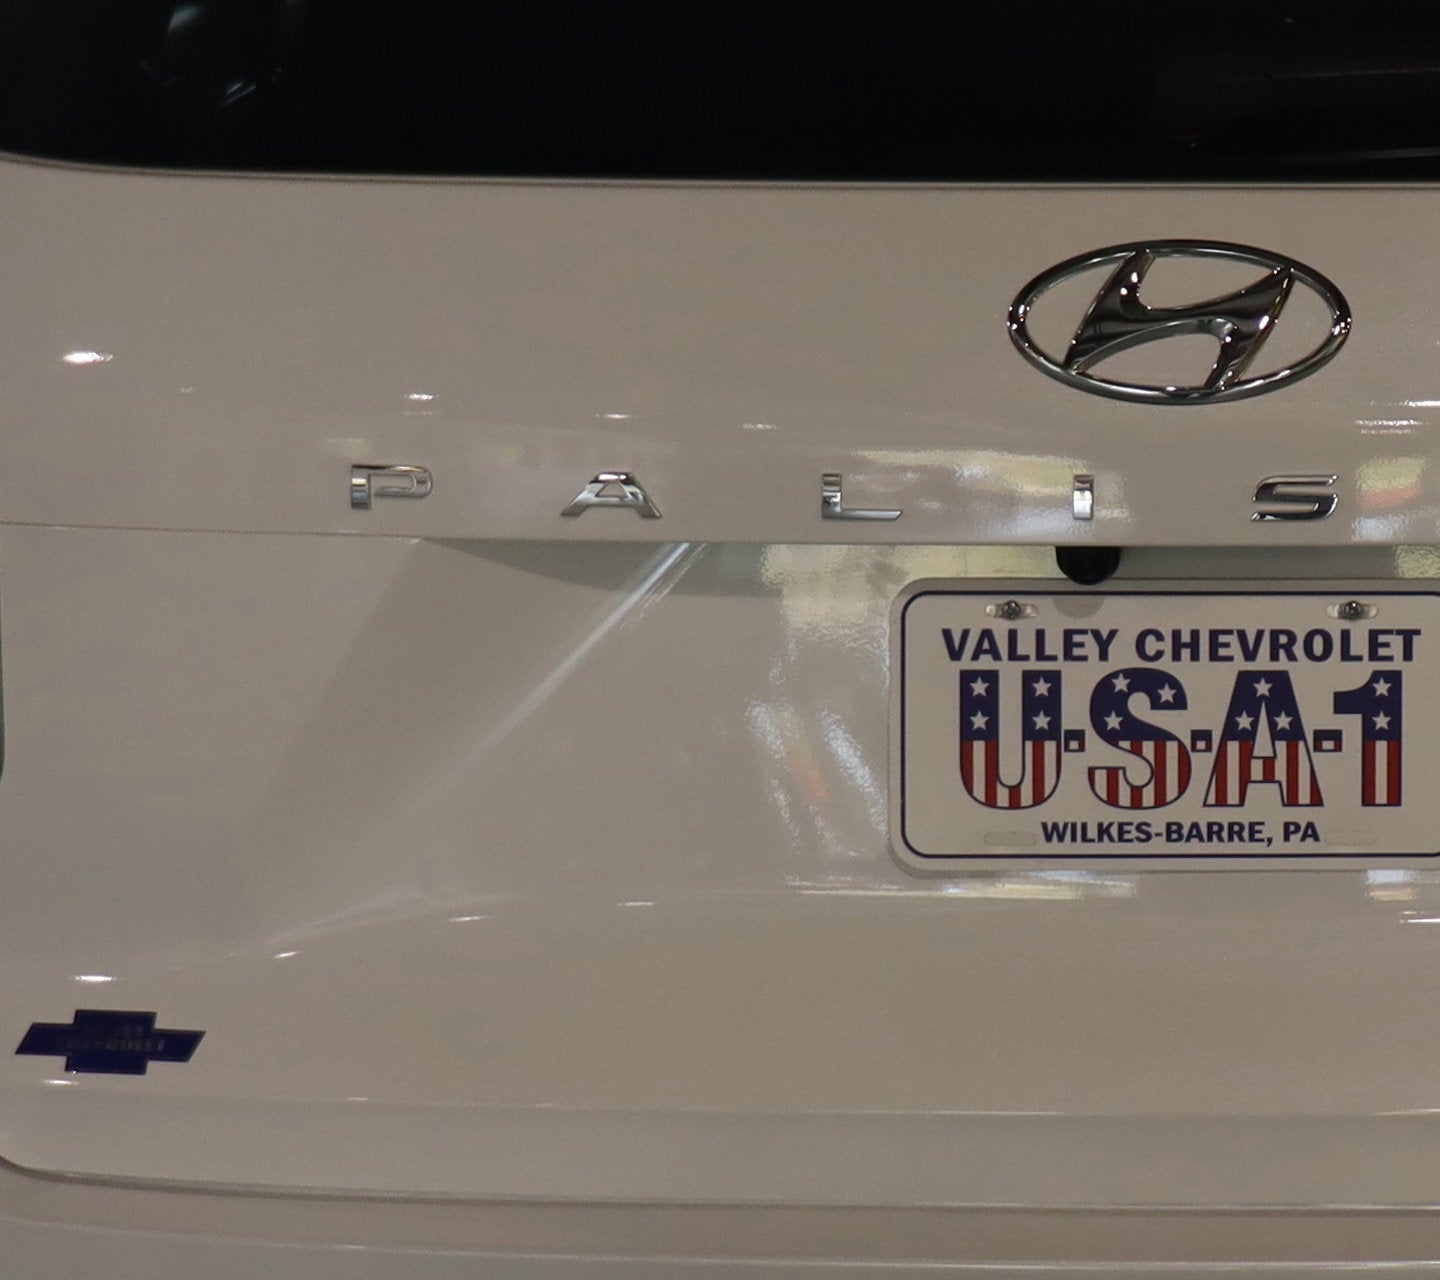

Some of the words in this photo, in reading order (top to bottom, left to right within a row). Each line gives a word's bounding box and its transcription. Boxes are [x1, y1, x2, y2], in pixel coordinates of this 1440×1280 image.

[941, 628, 1119, 662] VALLEY
[1134, 628, 1422, 662] CHEVROLET
[1041, 821, 1275, 848] WILKES-BARRE,
[1282, 821, 1320, 844] PA
